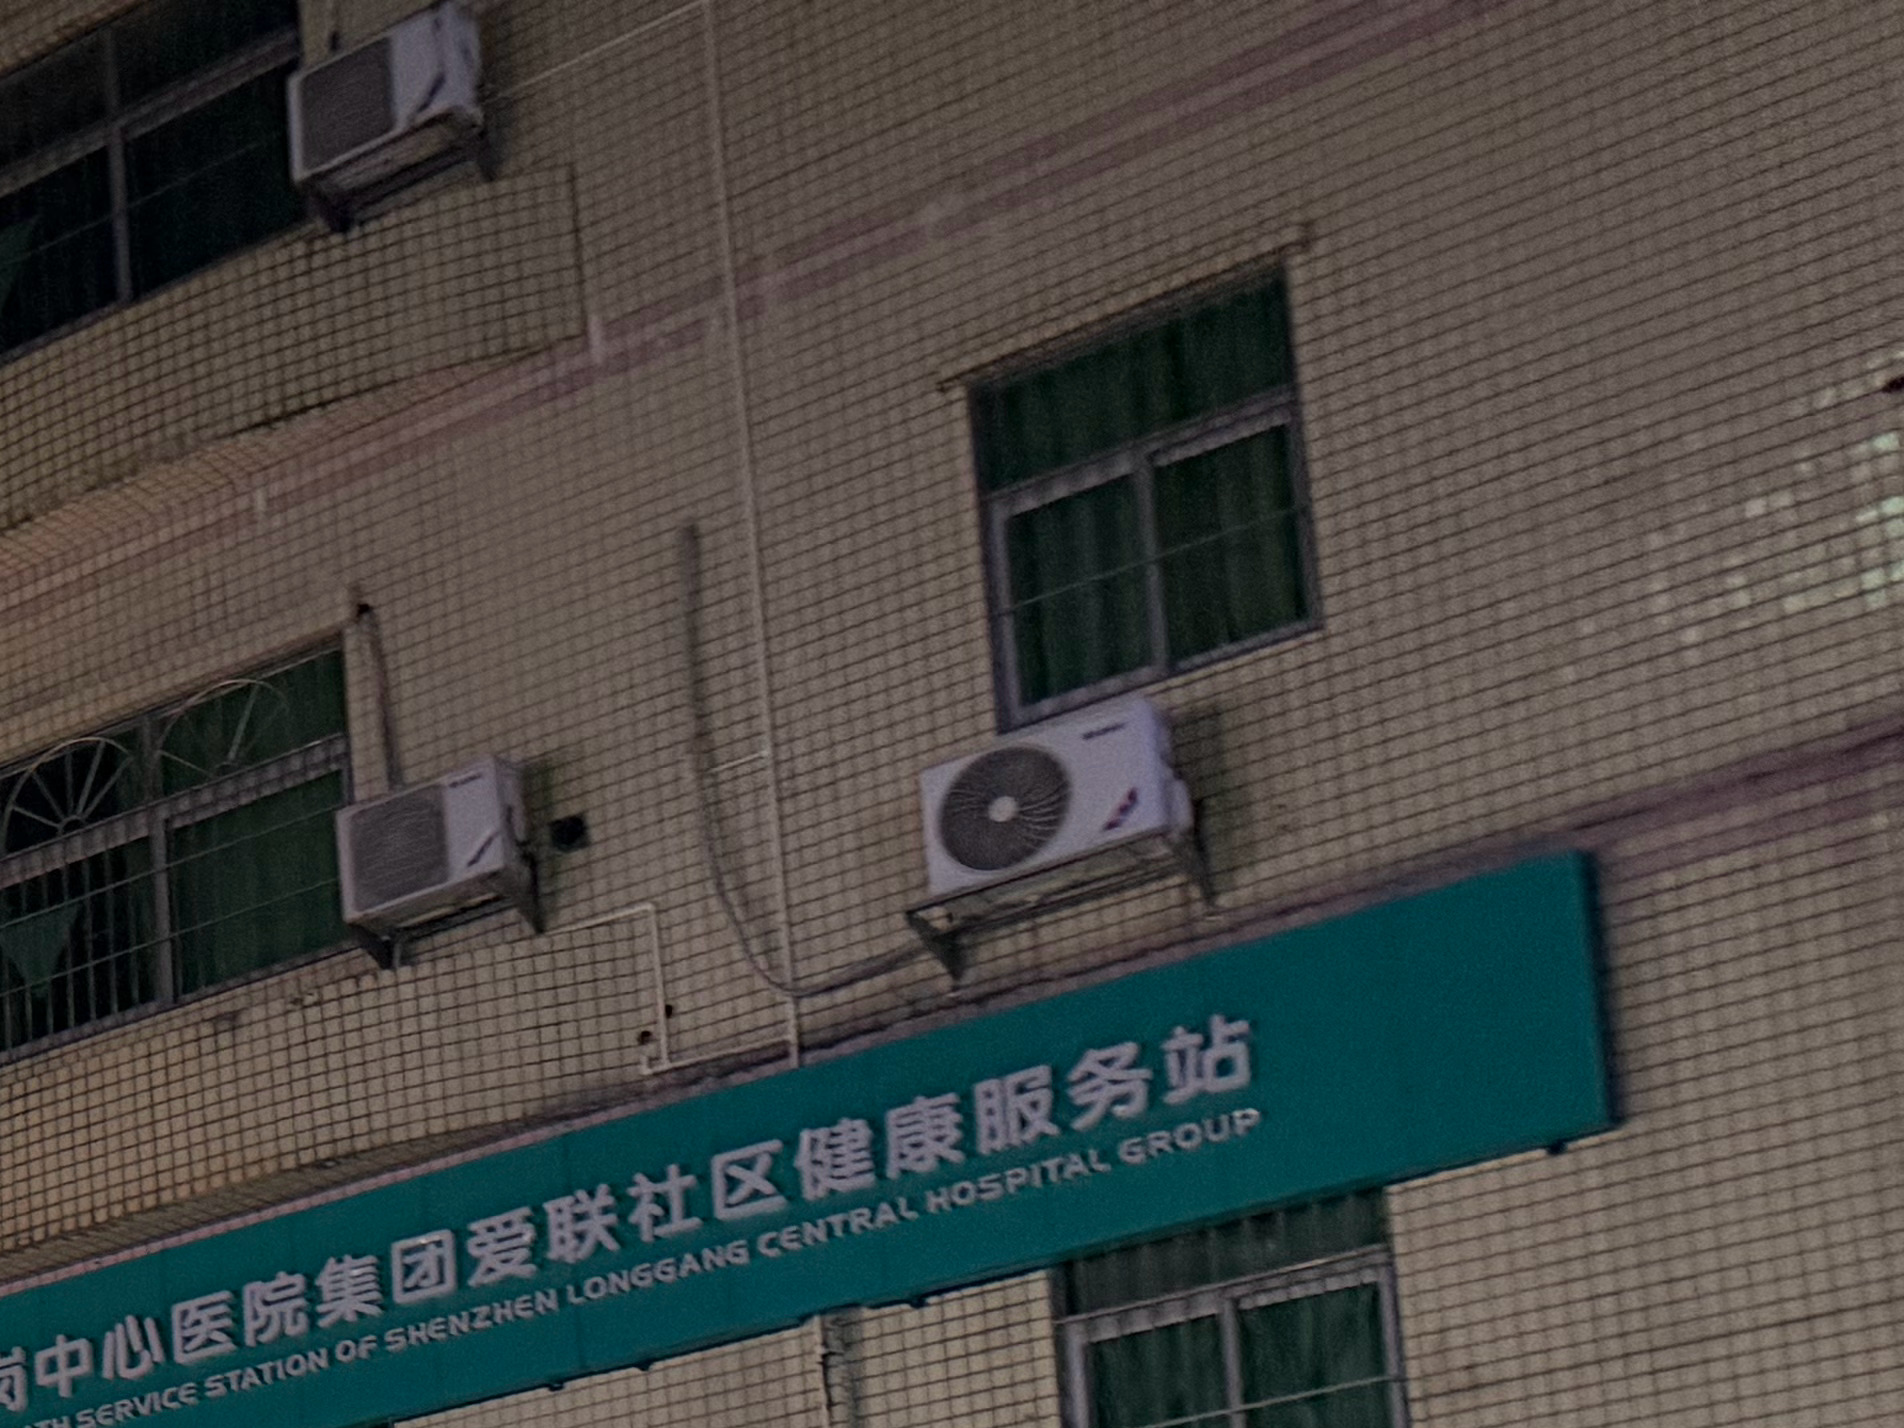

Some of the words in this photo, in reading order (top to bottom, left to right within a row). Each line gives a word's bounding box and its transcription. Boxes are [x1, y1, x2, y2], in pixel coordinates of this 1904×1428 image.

[204, 1347, 328, 1399] STATION
[335, 1334, 378, 1363] OF
[385, 1289, 559, 1351] SHENZHEN
[566, 1240, 749, 1304] LONGGANG
[757, 1195, 919, 1257] CENTRAL
[925, 1151, 1112, 1214] HOSPITAL
[1118, 1107, 1261, 1164] GROUP
